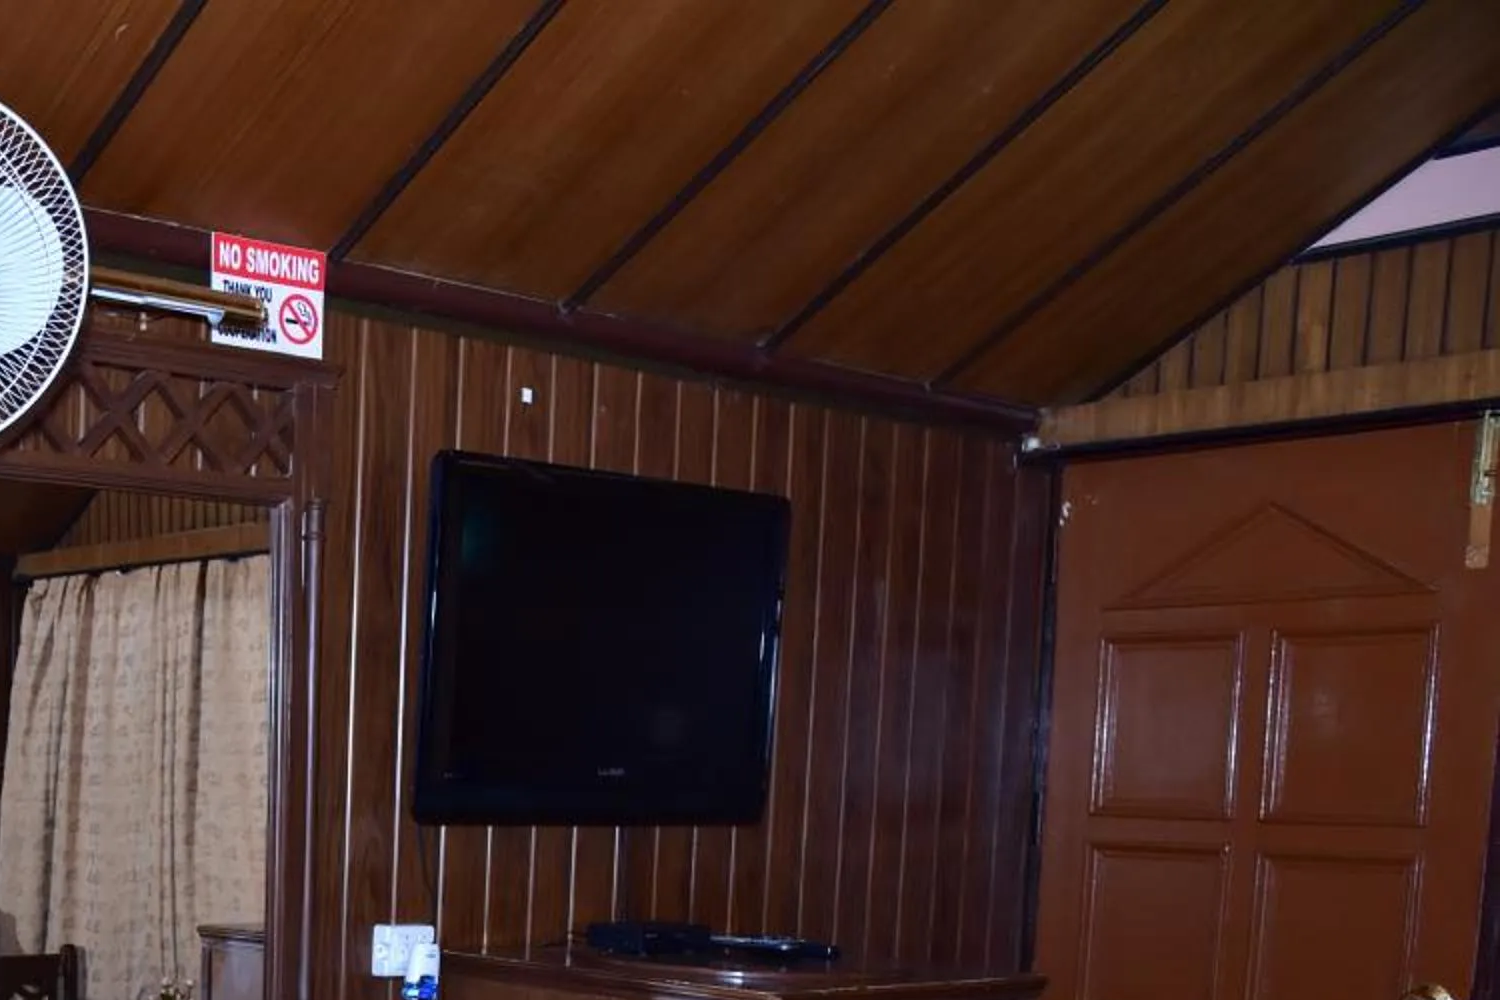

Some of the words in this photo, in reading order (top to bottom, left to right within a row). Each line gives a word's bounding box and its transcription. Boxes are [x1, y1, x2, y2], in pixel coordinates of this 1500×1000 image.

[219, 240, 241, 270] NO
[245, 247, 320, 284] SMOKING
[254, 284, 273, 303] YOU
